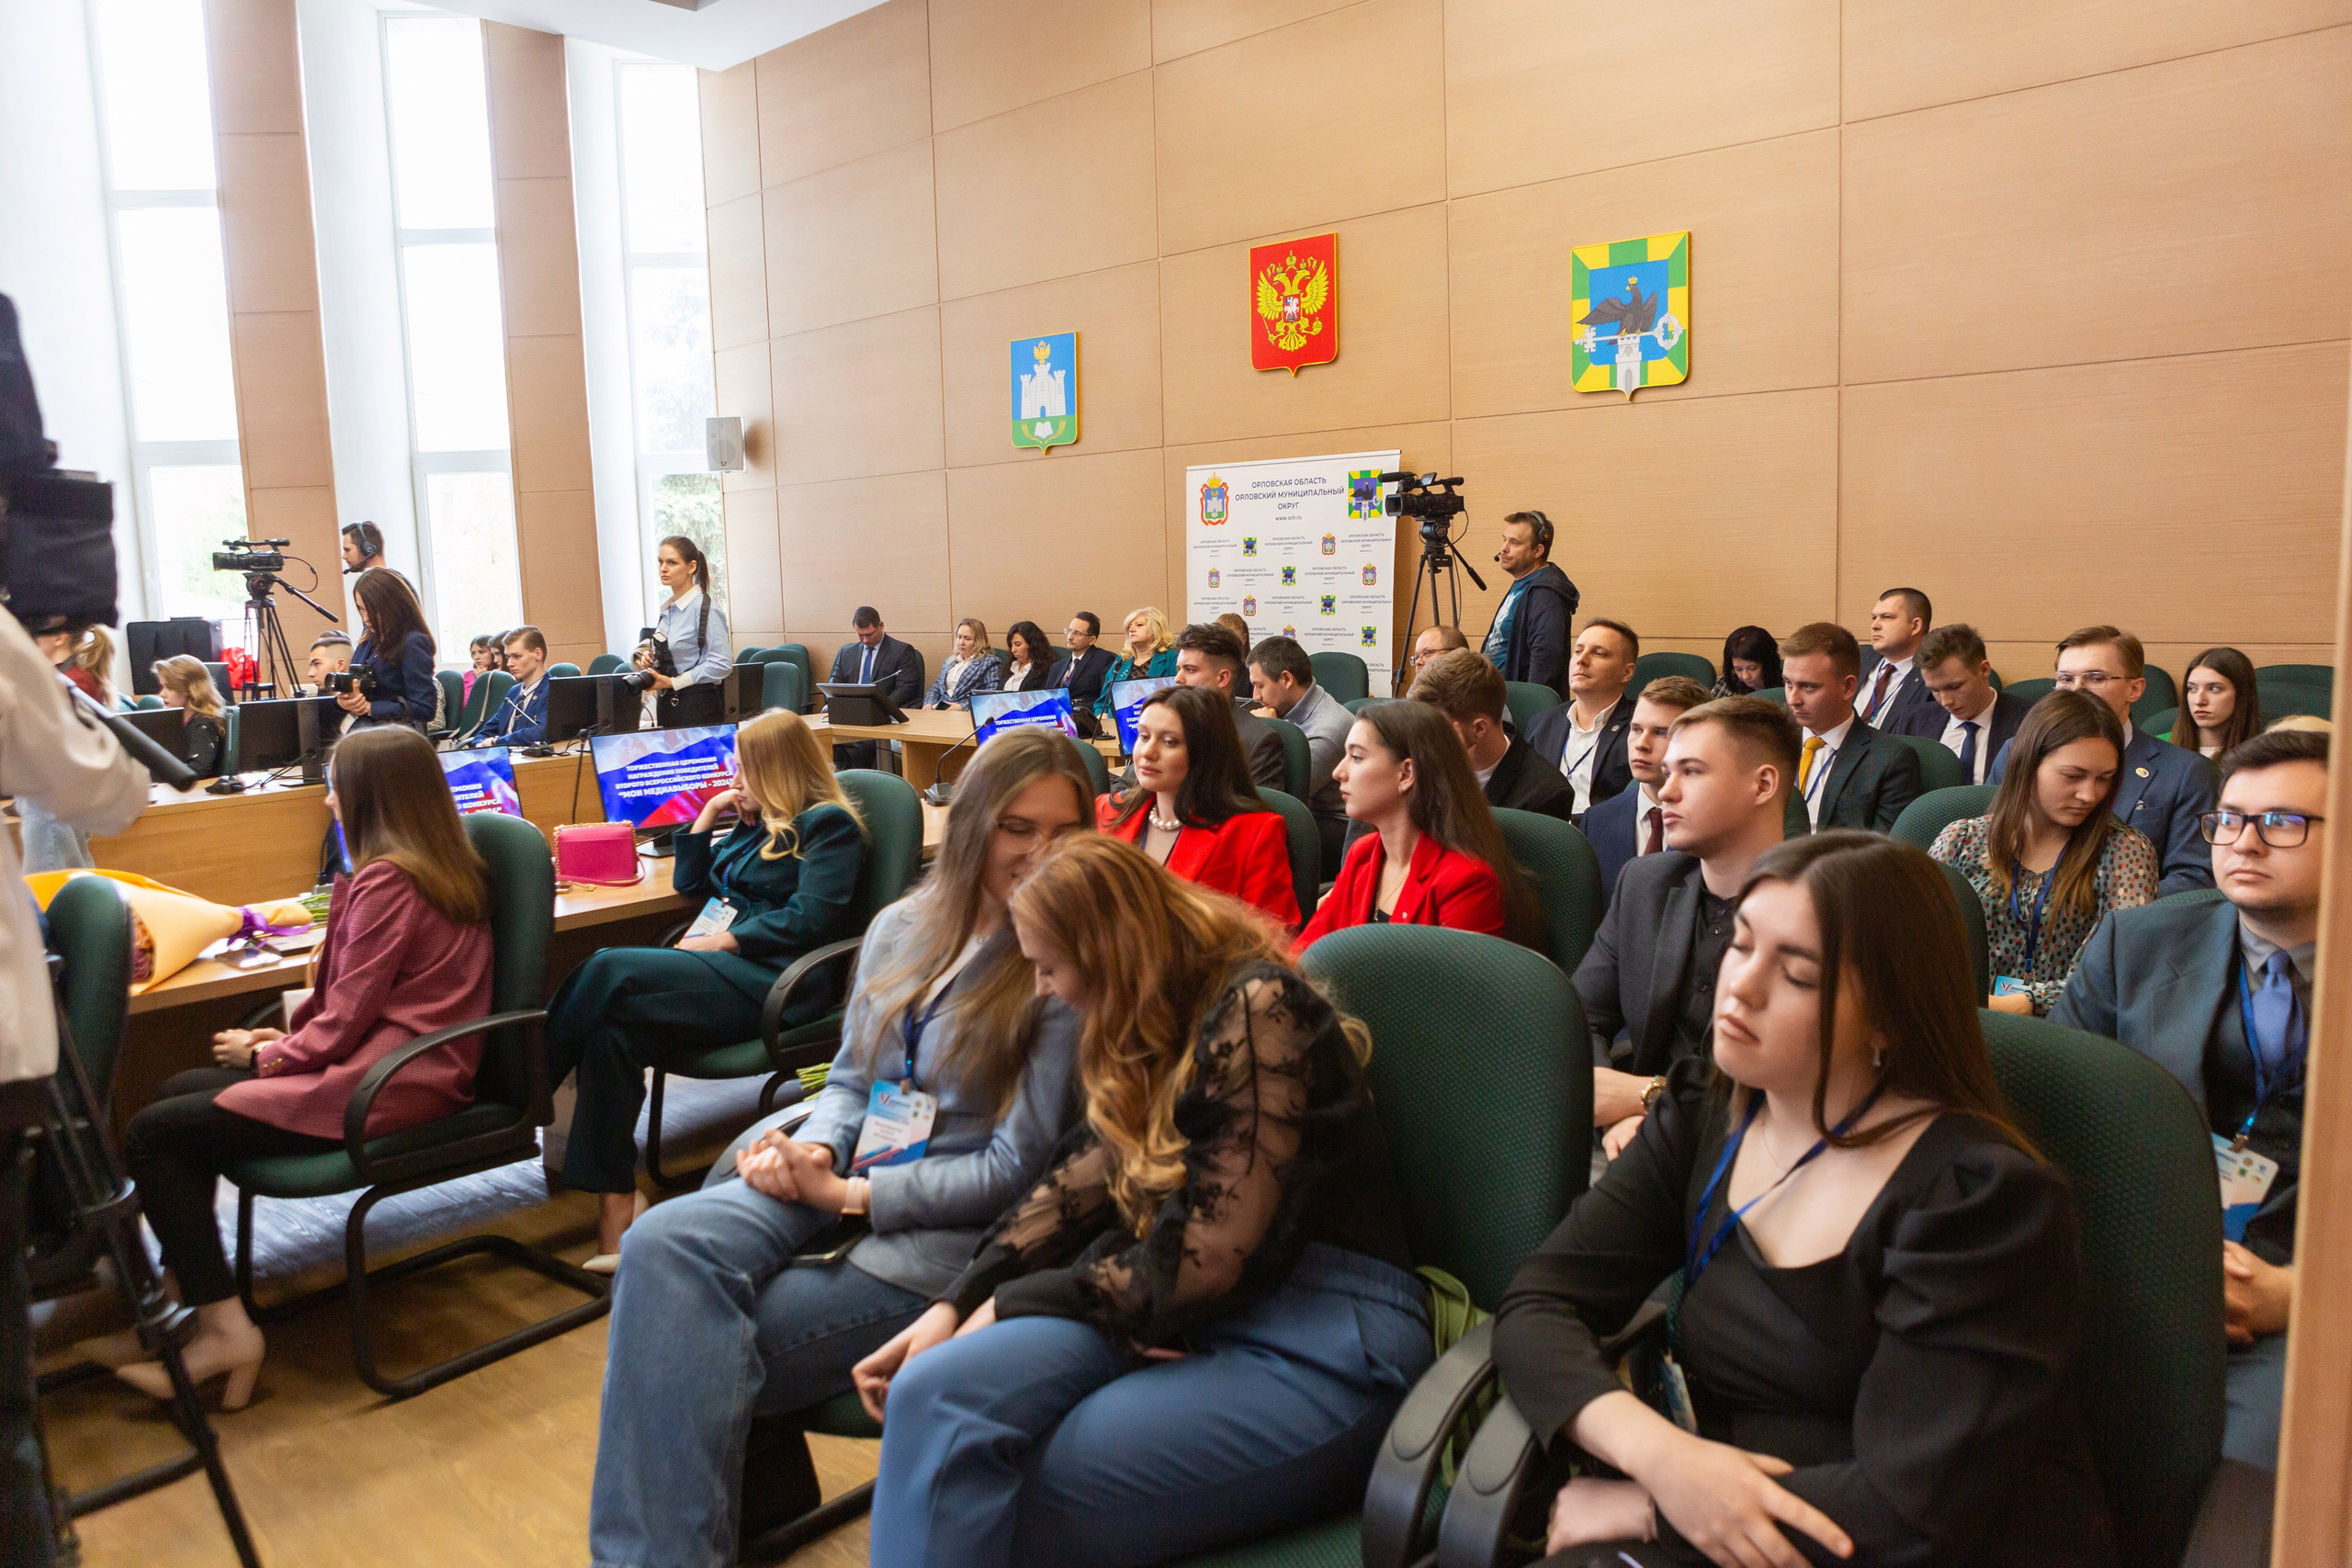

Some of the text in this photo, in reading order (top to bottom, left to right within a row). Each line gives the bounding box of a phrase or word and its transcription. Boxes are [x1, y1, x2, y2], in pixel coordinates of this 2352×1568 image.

[1251, 477, 1327, 489] ОРЛОВСКАЯ ОБЛАСТЬ
[1235, 487, 1345, 502] ОРЛОВСКИЙ МУНИЦИПАЛЬНЫЙ
[1278, 502, 1299, 511] ОКРУГ
[626, 757, 718, 772] ТОРЖЕСТВЕННАЯ ЦЕРЕМОНИЯ
[628, 762, 719, 780] НАГРАЖДЕНИЯ ПОБЕДИТЕЛЕЙ
[645, 774, 702, 786] ВСЕРОССИЙСКОГО
[450, 783, 482, 793] ЕМОНИЯ
[643, 782, 707, 795] МЕДИАВЫБОРЫ
